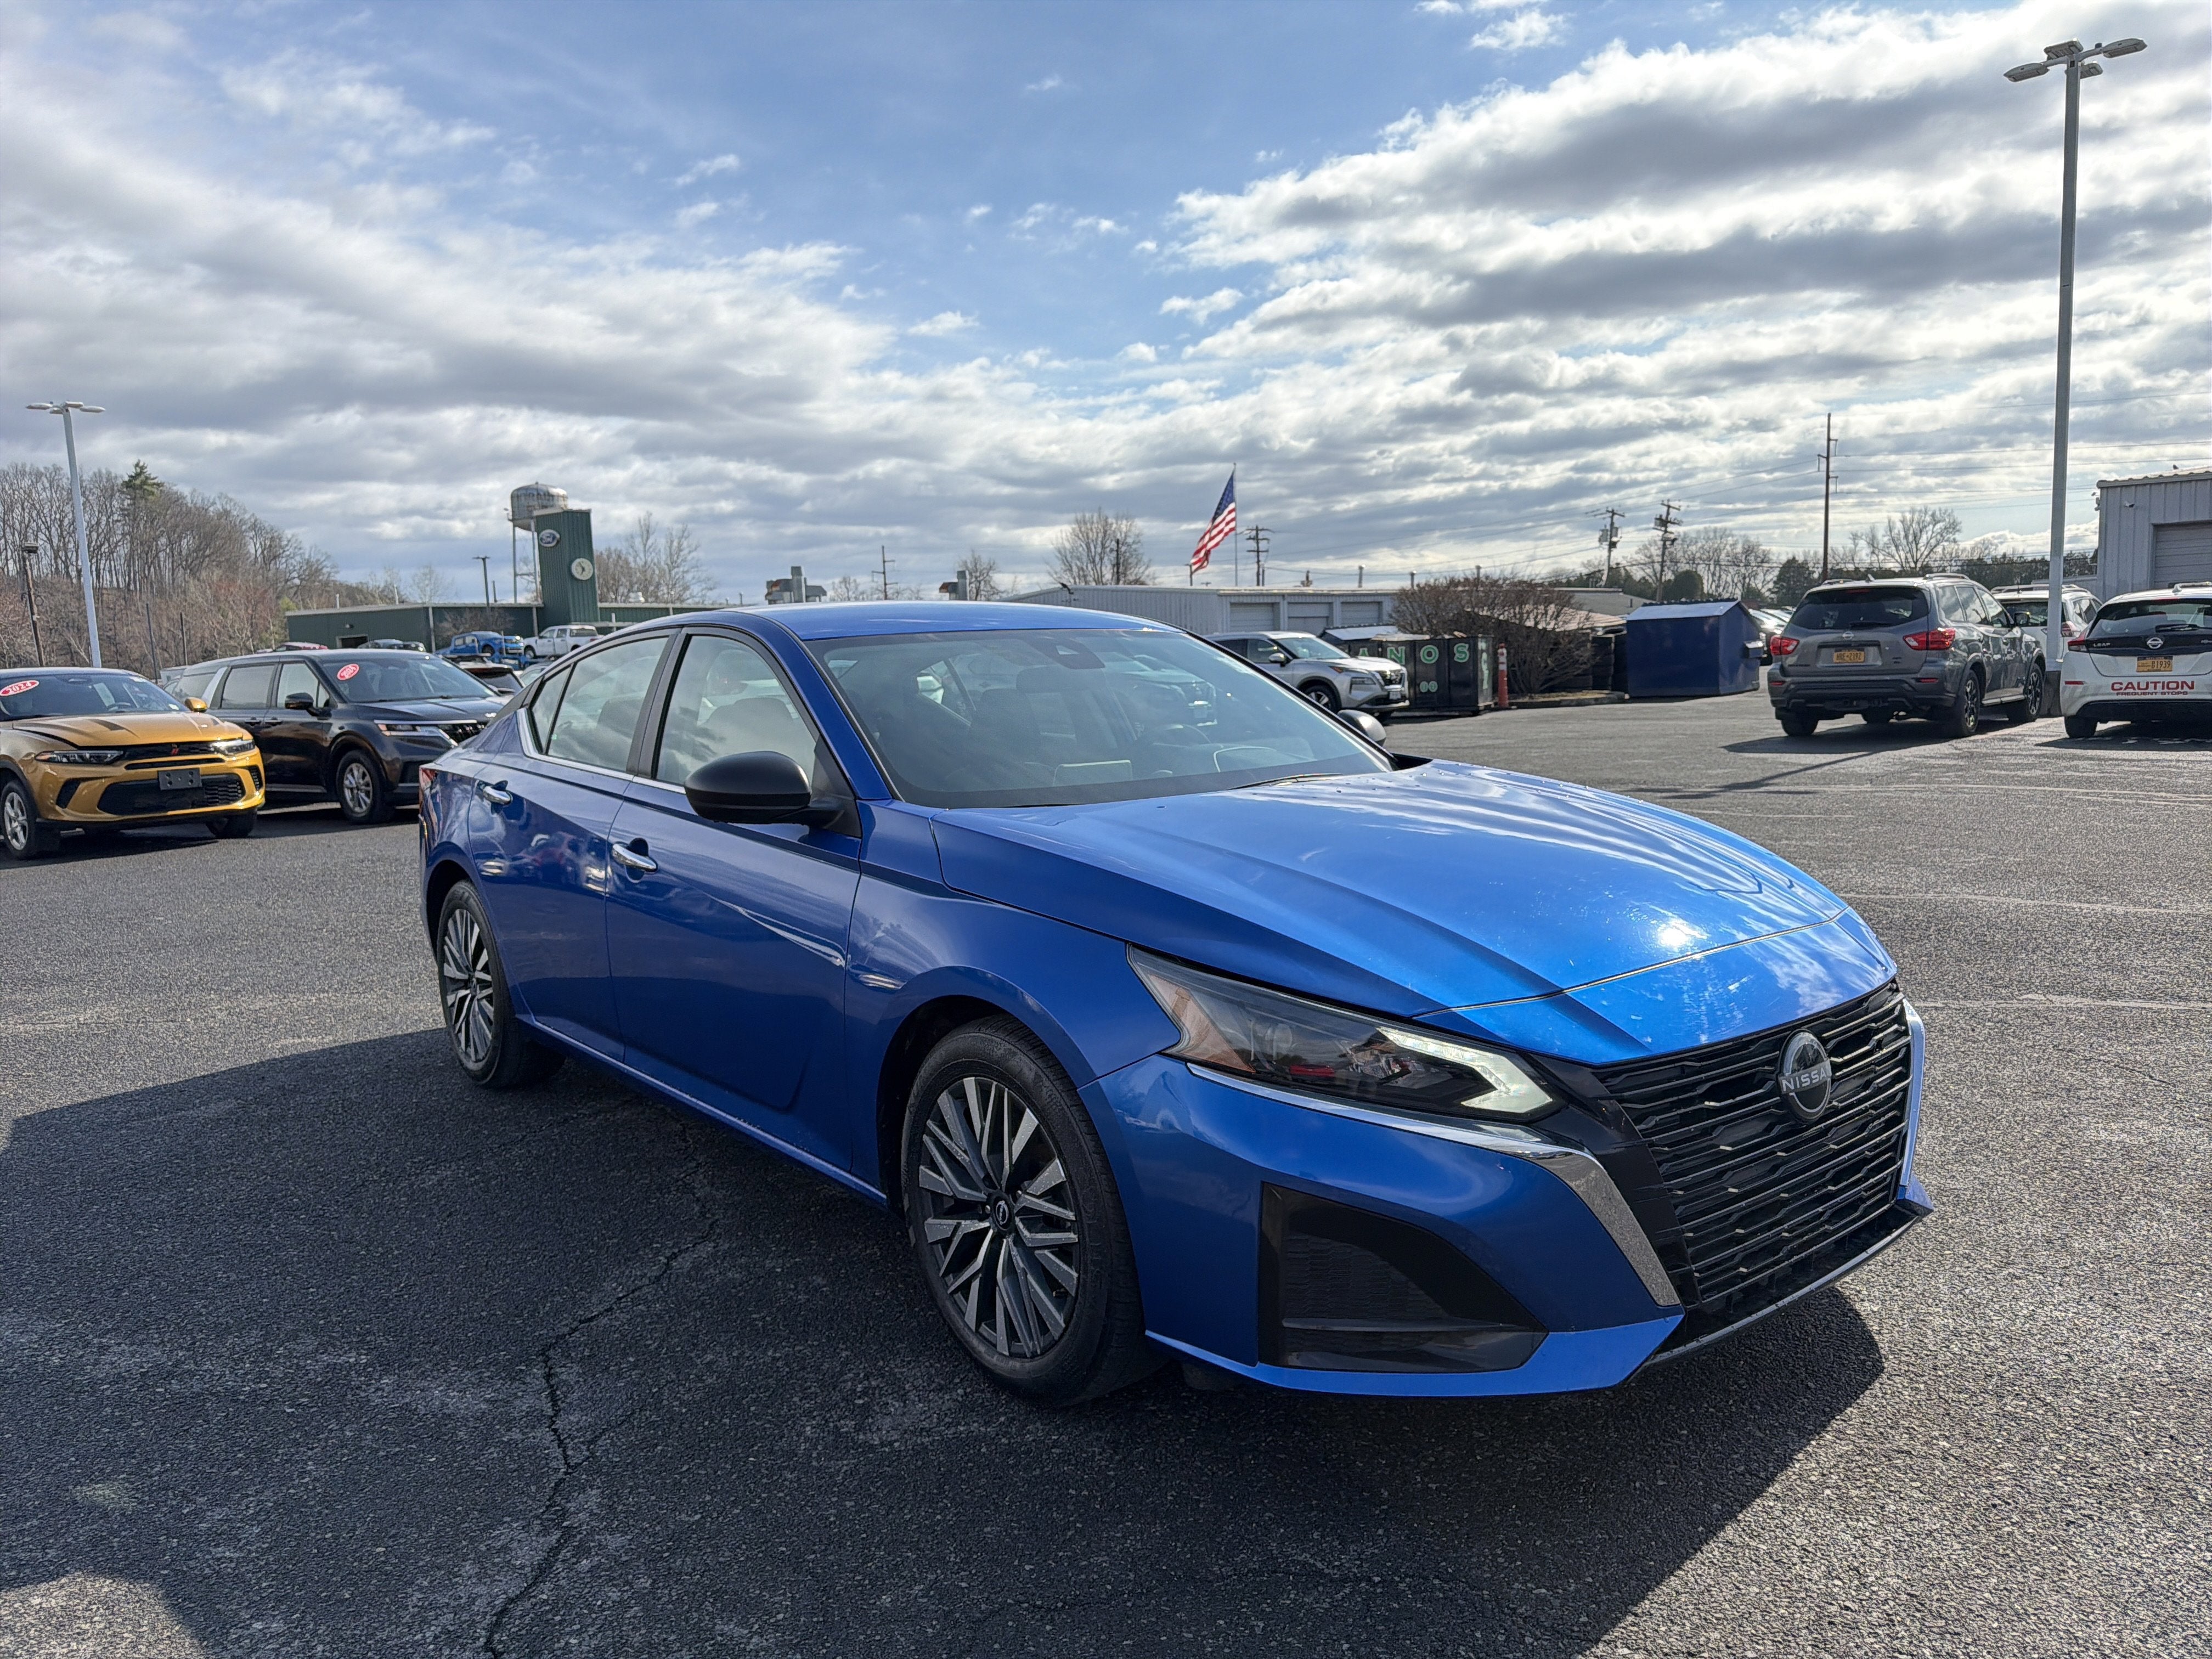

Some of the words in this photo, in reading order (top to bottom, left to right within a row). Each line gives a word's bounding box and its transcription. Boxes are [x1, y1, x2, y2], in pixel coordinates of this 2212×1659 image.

[6, 681, 32, 694] 2024
[2111, 681, 2194, 691] CAUTION
[1781, 1066, 1829, 1092] NISSA
